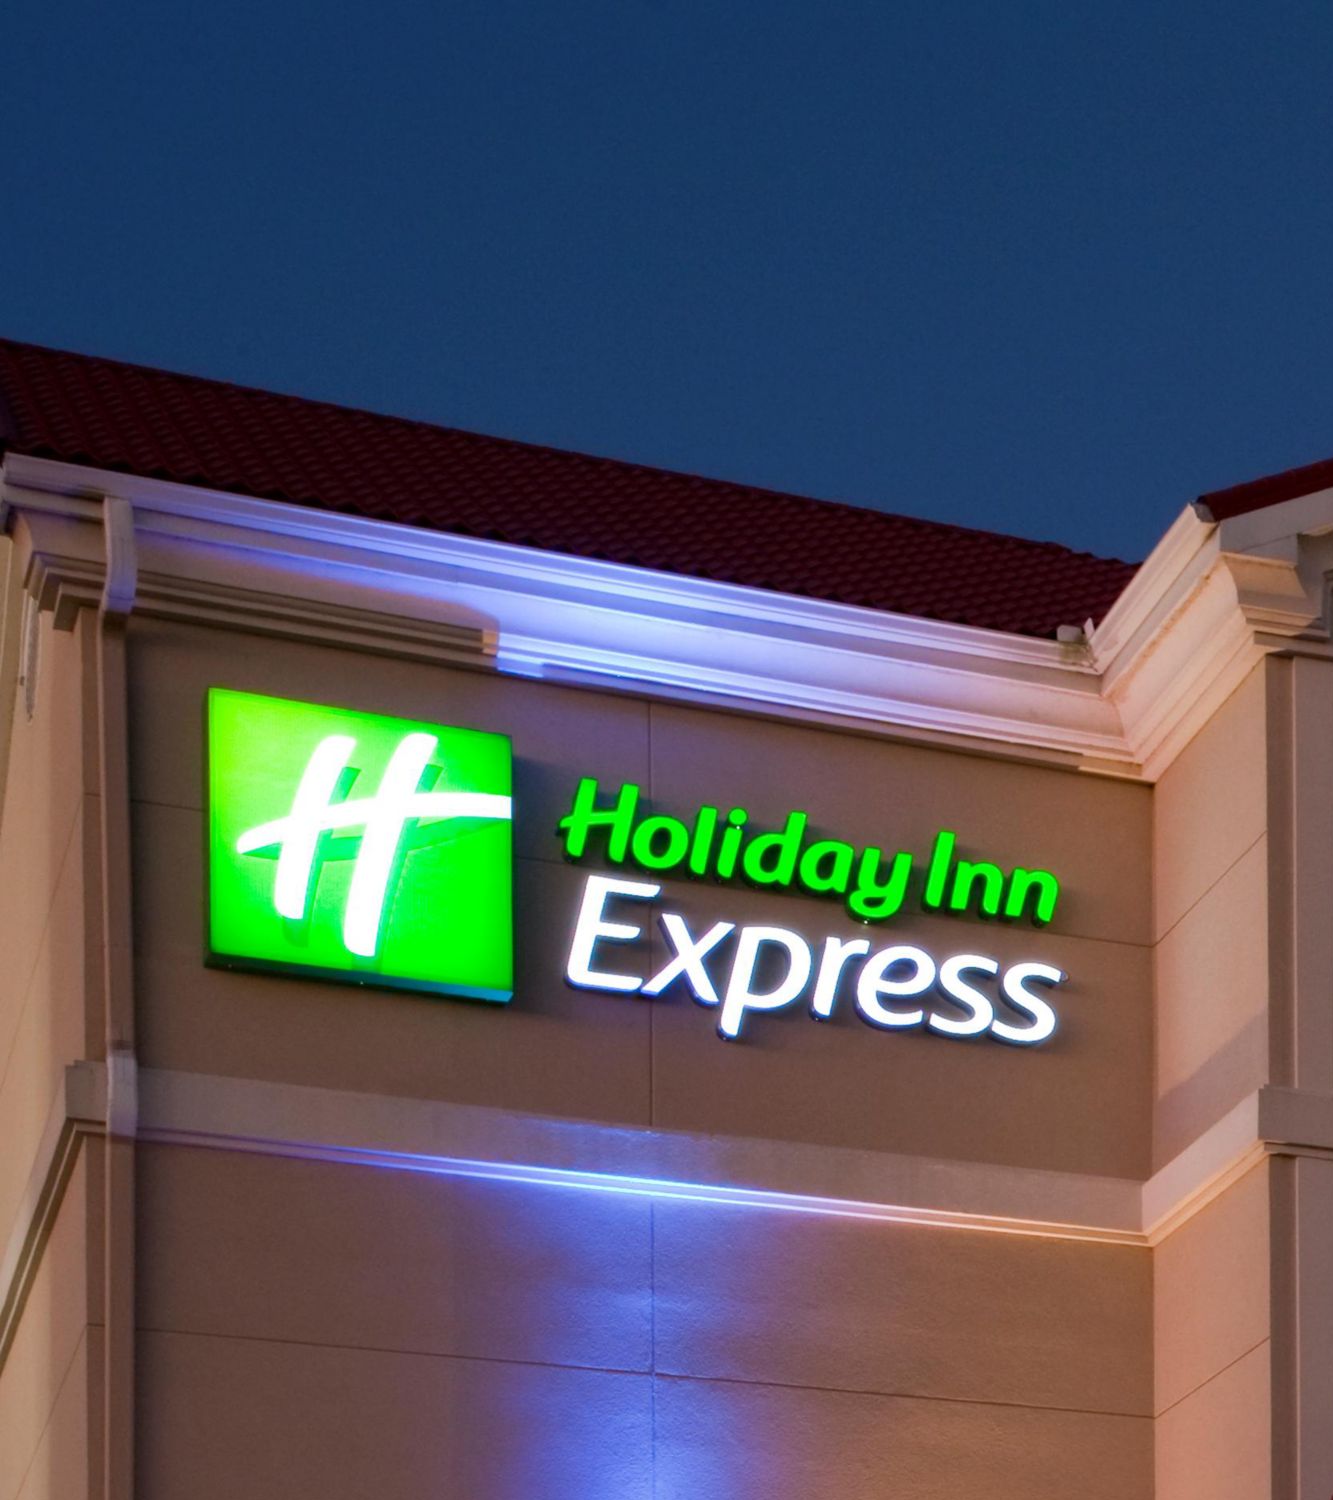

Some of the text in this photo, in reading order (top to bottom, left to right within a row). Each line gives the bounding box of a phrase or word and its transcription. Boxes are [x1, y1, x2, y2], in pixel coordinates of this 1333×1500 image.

[558, 776, 1060, 923] Holiday Inn
[565, 874, 1064, 1043] Express
